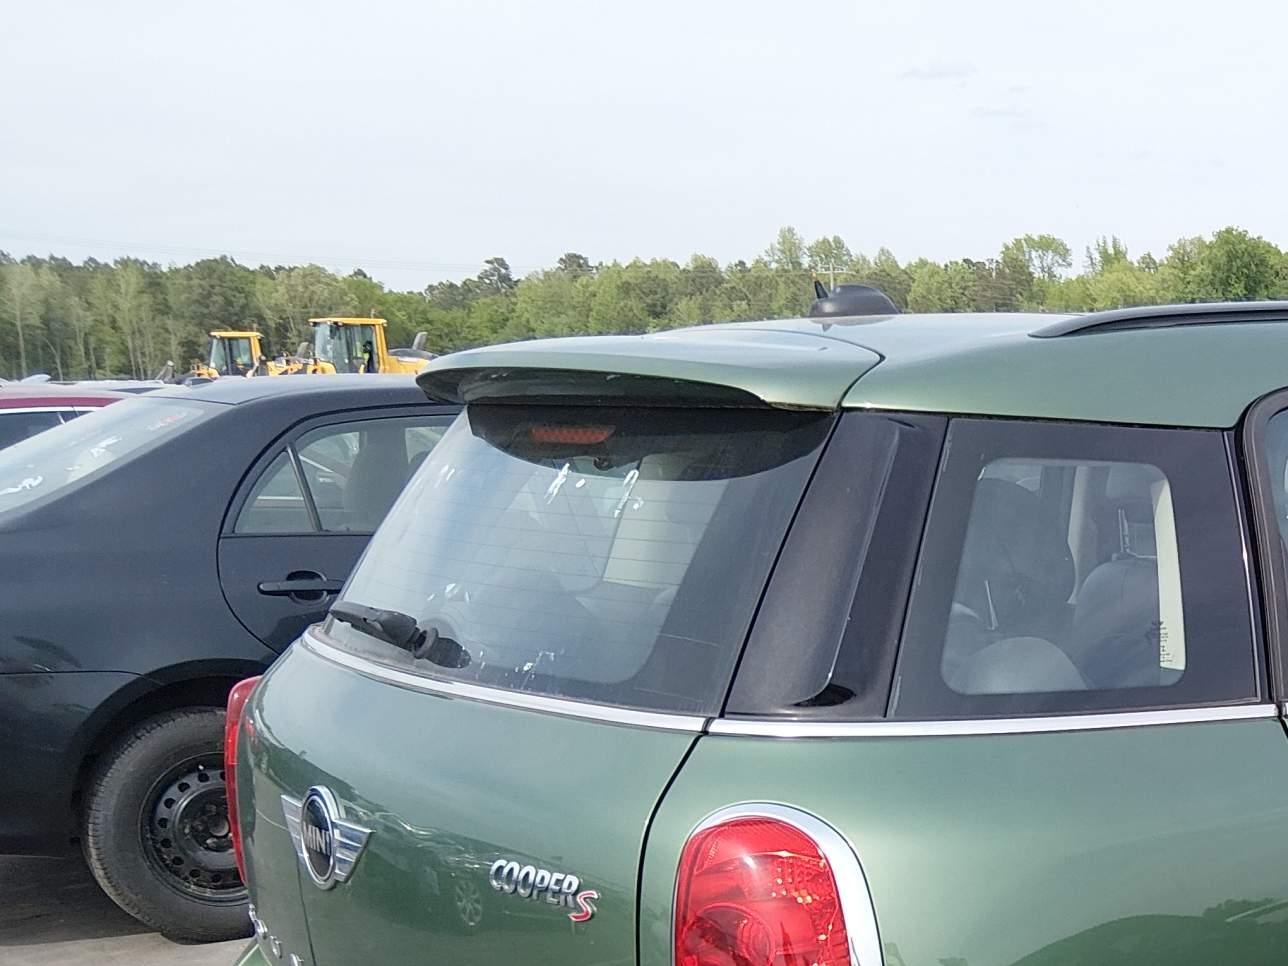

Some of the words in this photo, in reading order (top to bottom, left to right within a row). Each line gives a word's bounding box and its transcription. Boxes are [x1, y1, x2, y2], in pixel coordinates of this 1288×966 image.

[302, 821, 332, 857] MINI
[489, 859, 580, 909] COOPER
[568, 890, 599, 922] S
